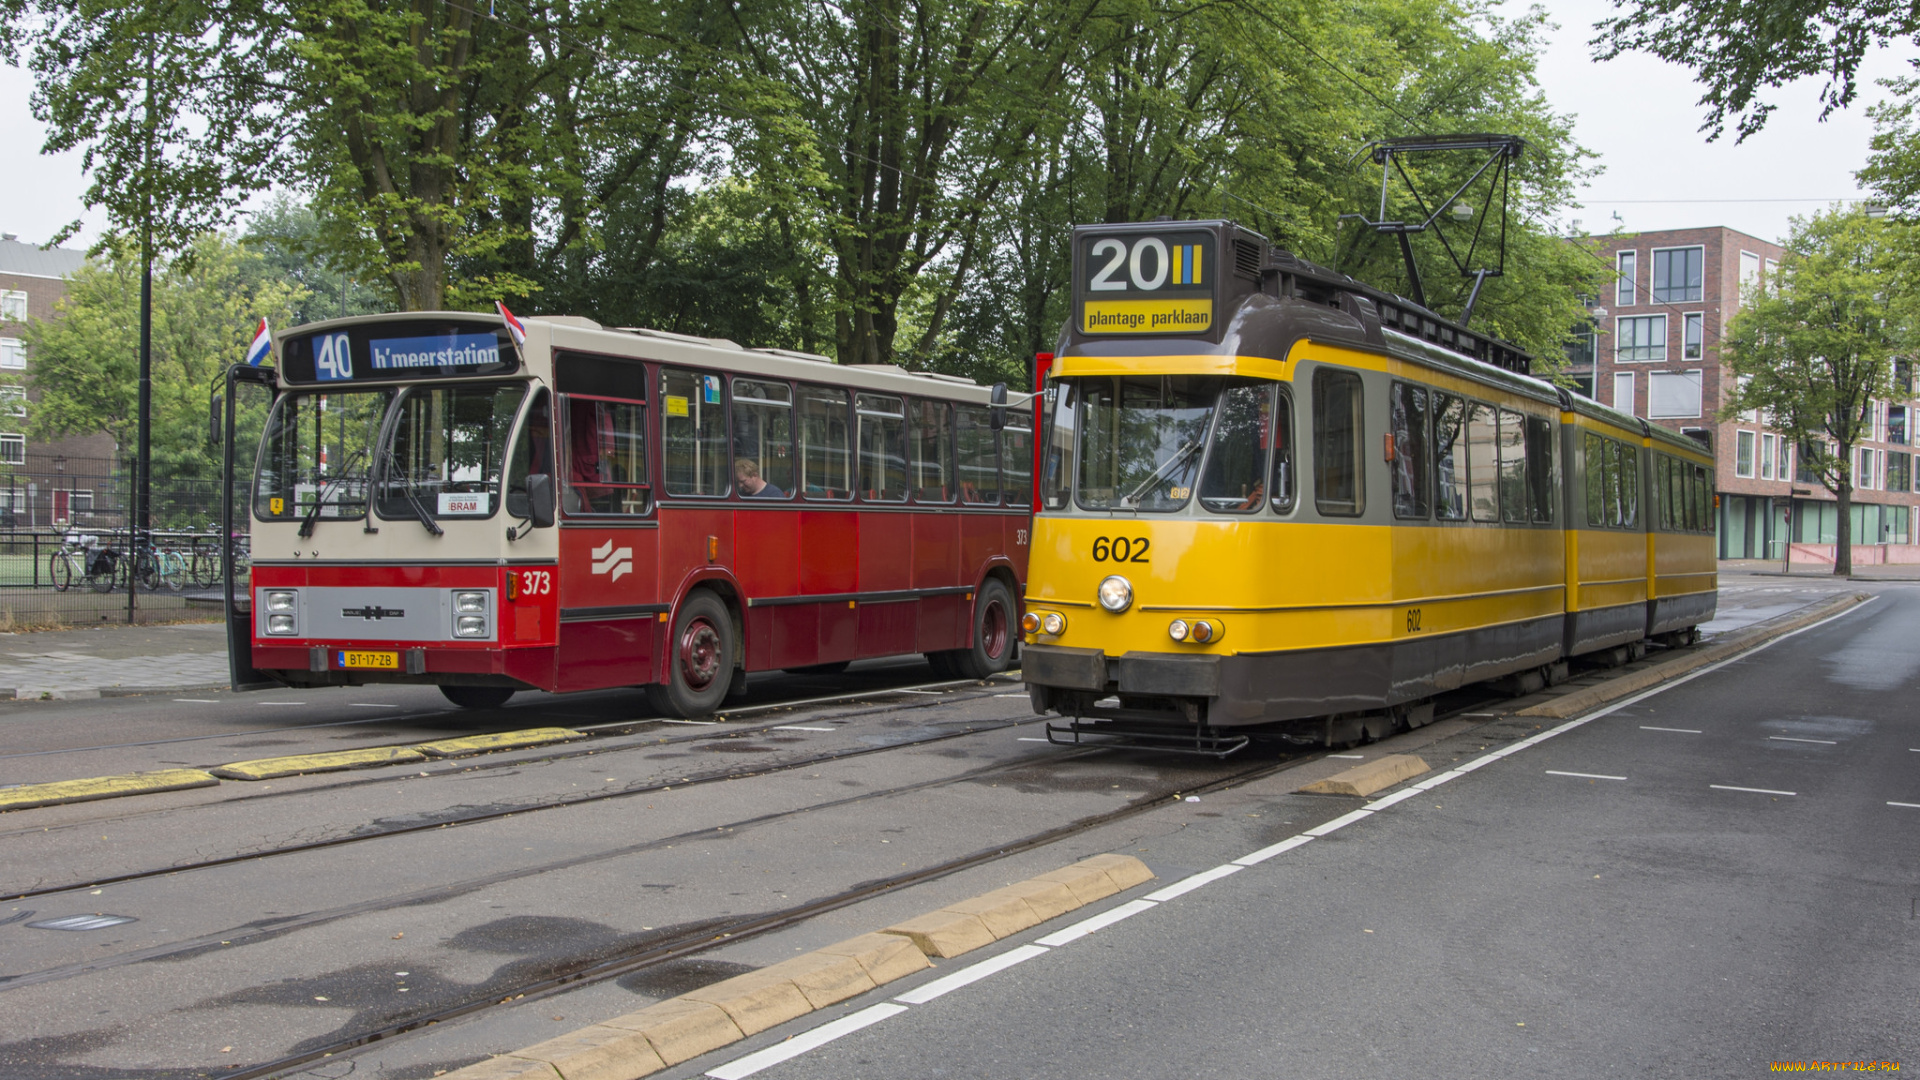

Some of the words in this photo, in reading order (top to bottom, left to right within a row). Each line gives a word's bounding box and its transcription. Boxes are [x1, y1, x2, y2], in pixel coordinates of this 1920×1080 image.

[1090, 237, 1169, 291] 20
[1089, 311, 1145, 328] plantage
[1151, 309, 1208, 328] parklaan
[318, 334, 353, 378] 40
[374, 343, 500, 369] h'meerstation
[450, 502, 477, 511] BRAM
[1016, 529, 1028, 545] 373
[1092, 536, 1150, 563] 602
[522, 571, 551, 595] 373
[1406, 609, 1421, 632] 602
[349, 654, 392, 666] BT-17-ZB
